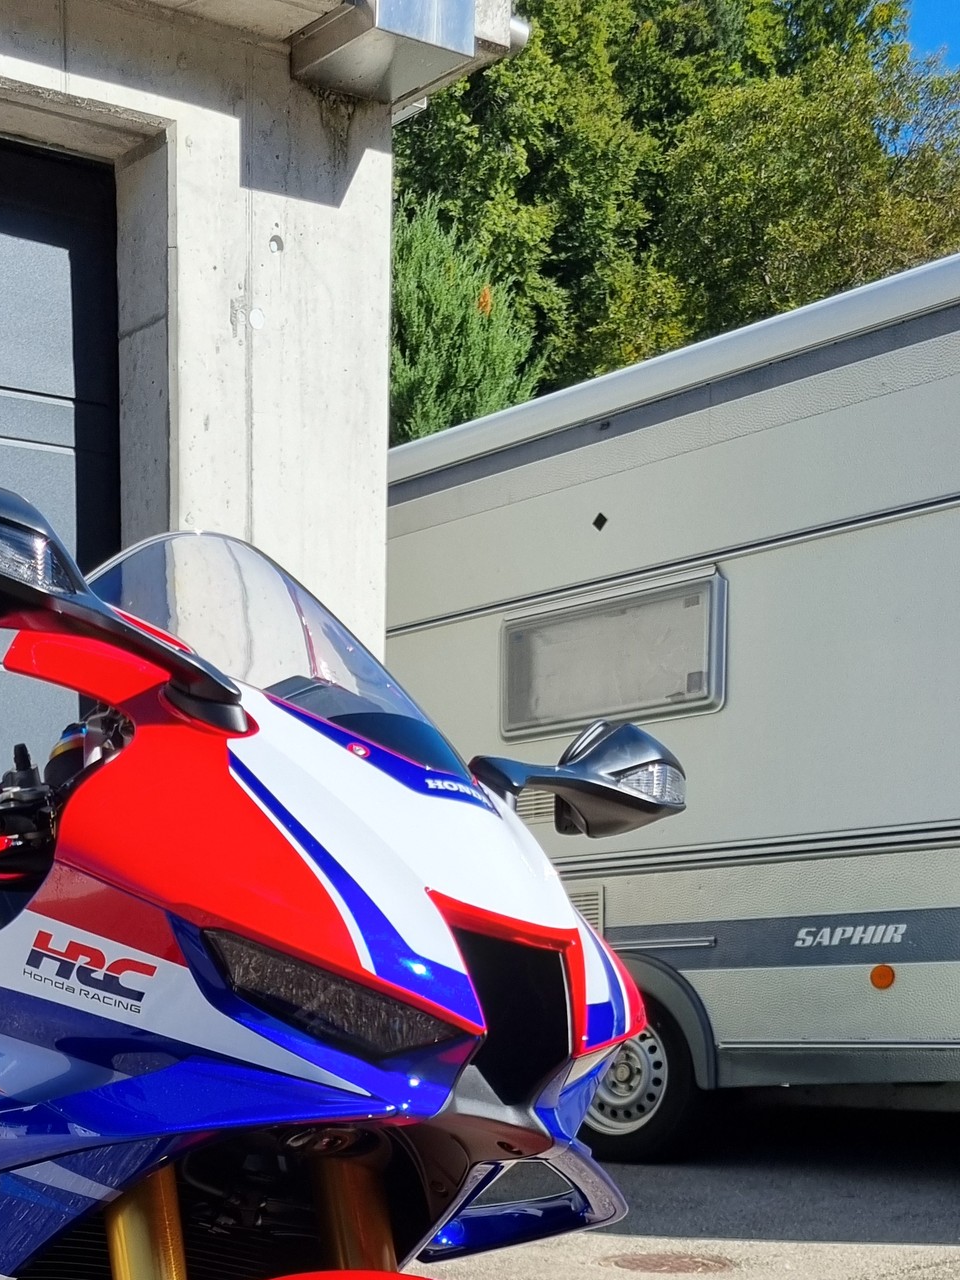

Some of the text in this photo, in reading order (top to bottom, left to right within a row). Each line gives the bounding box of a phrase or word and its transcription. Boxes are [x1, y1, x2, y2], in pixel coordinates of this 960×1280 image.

[794, 924, 908, 948] SAPHIR
[25, 929, 158, 1003] HRC
[23, 967, 142, 1015] Honda RACING
